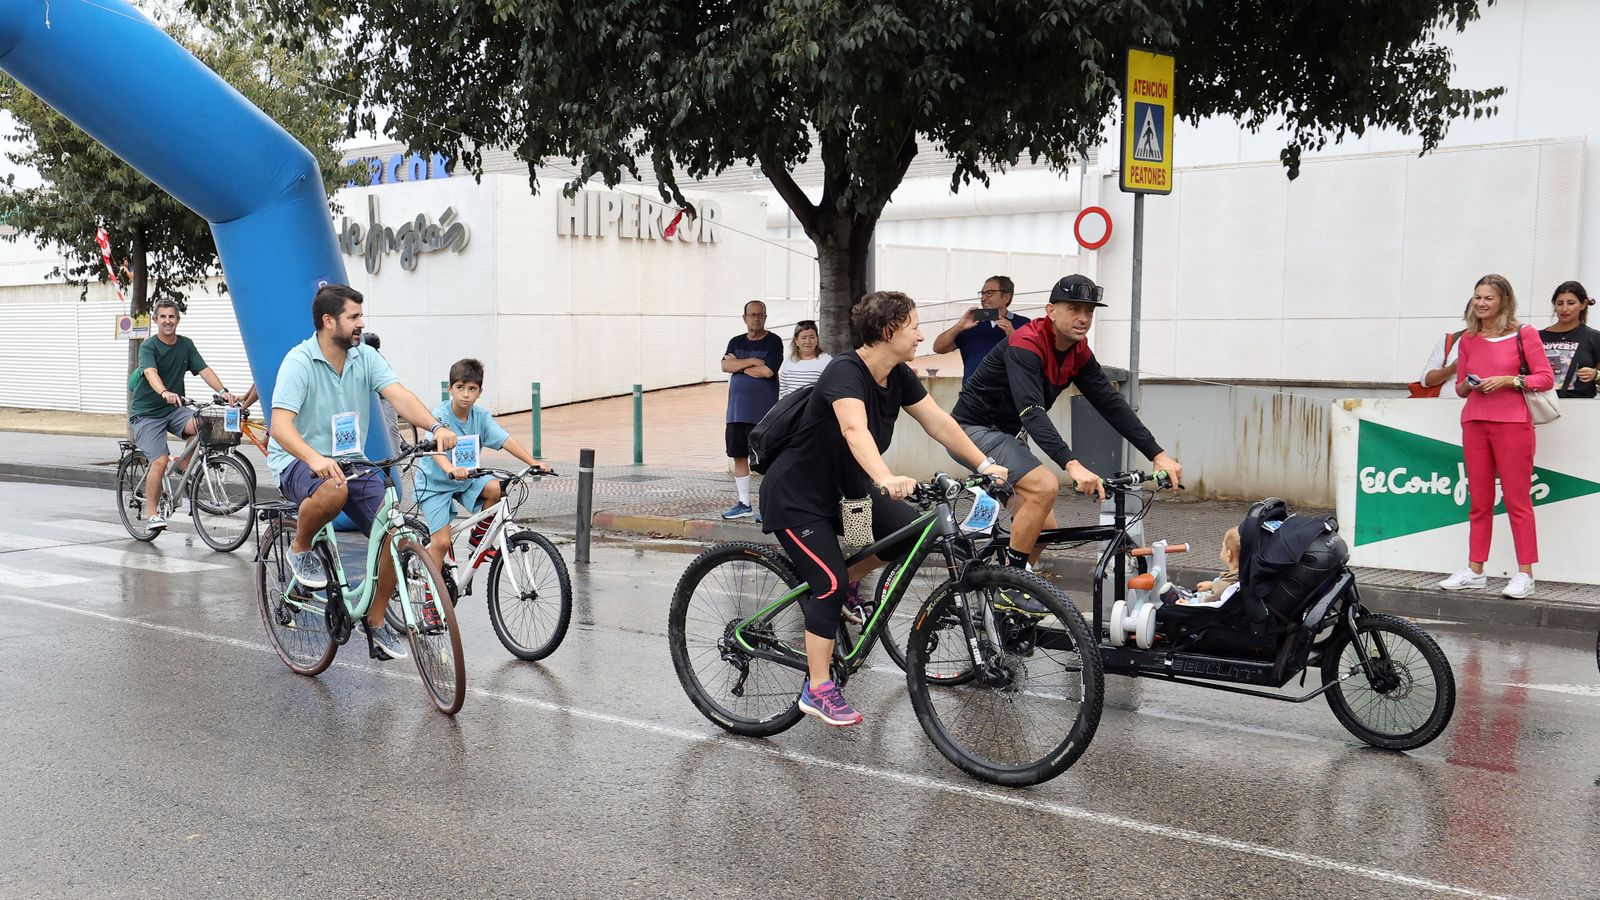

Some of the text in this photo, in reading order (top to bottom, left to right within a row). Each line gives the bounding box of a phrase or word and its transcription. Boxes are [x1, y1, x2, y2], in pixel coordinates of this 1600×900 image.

[1133, 78, 1168, 99] ATENCIÓN
[1130, 165, 1166, 186] PEATONES
[365, 194, 470, 274] Inglés
[1359, 466, 1388, 494] El
[1387, 466, 1452, 496] Corte
